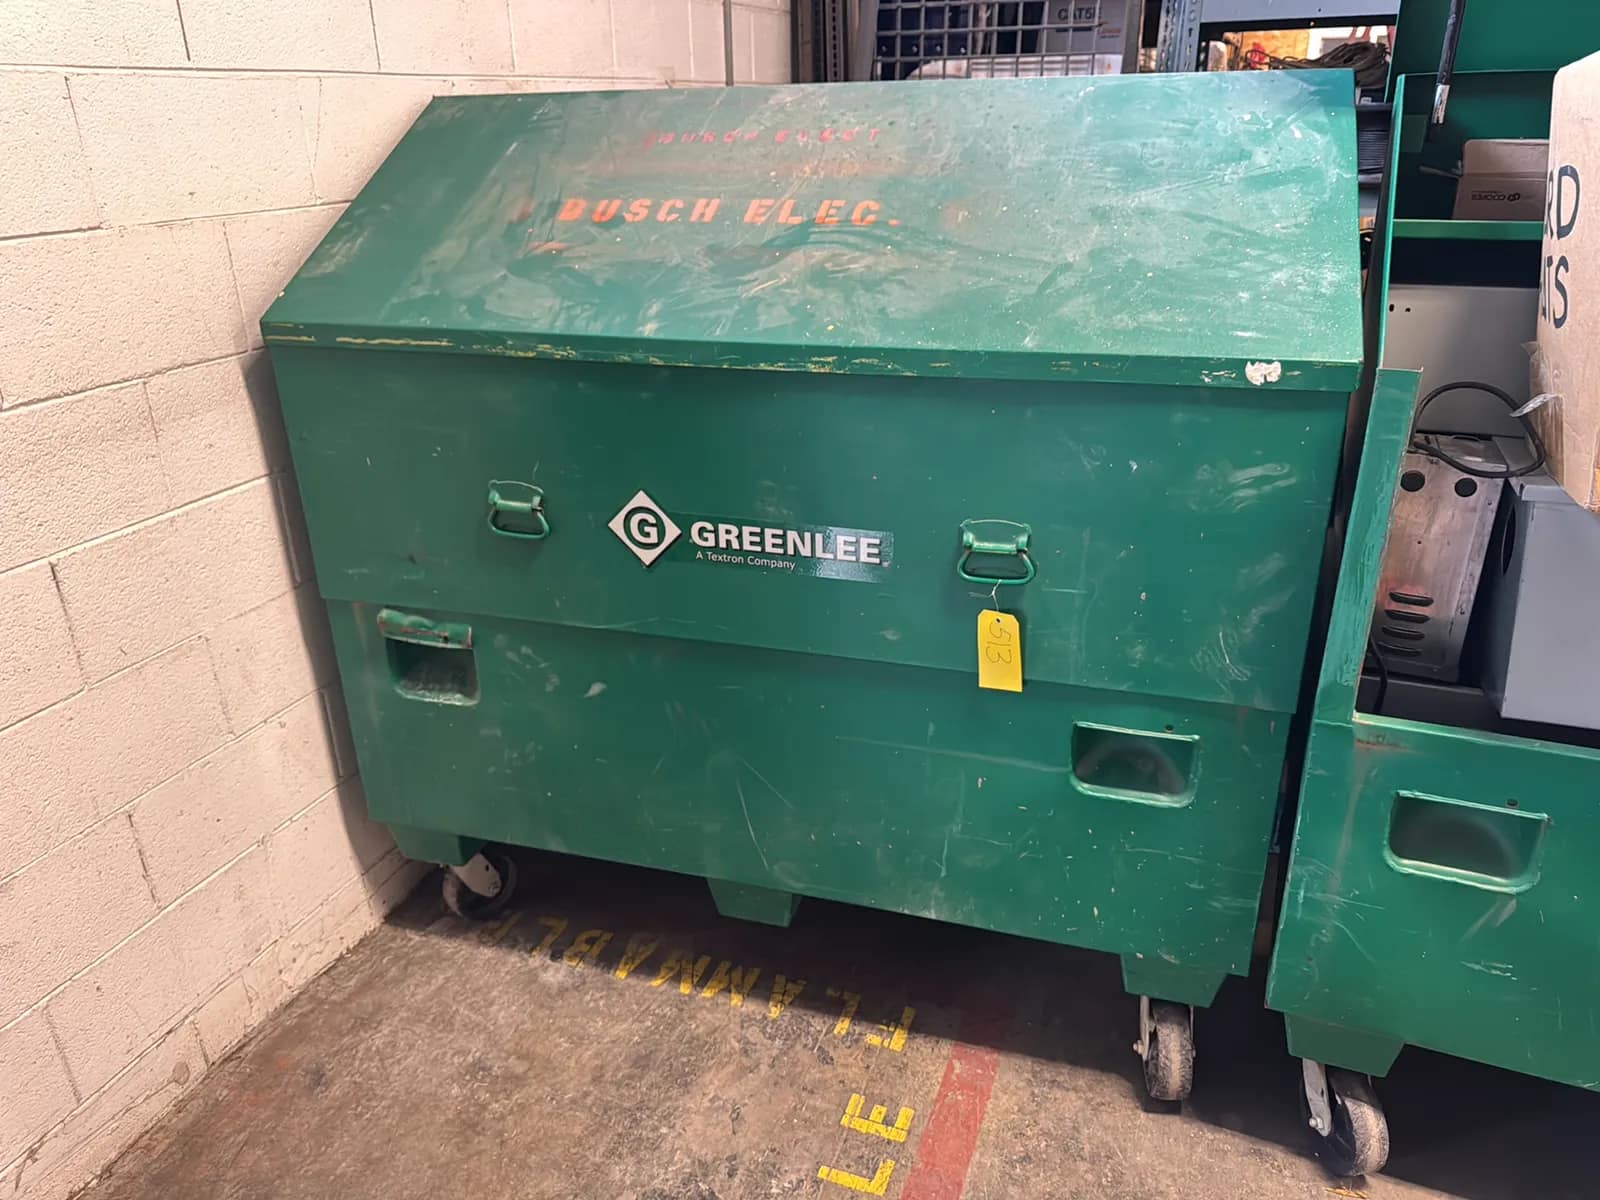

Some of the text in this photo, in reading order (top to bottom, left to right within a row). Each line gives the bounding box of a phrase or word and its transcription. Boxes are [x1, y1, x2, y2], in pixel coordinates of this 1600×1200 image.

[557, 199, 901, 226] BUSCH ELEC.
[630, 513, 659, 544] G
[690, 521, 881, 564] GREENLEE
[696, 551, 796, 571] A Textron Company
[986, 621, 1013, 665] 513
